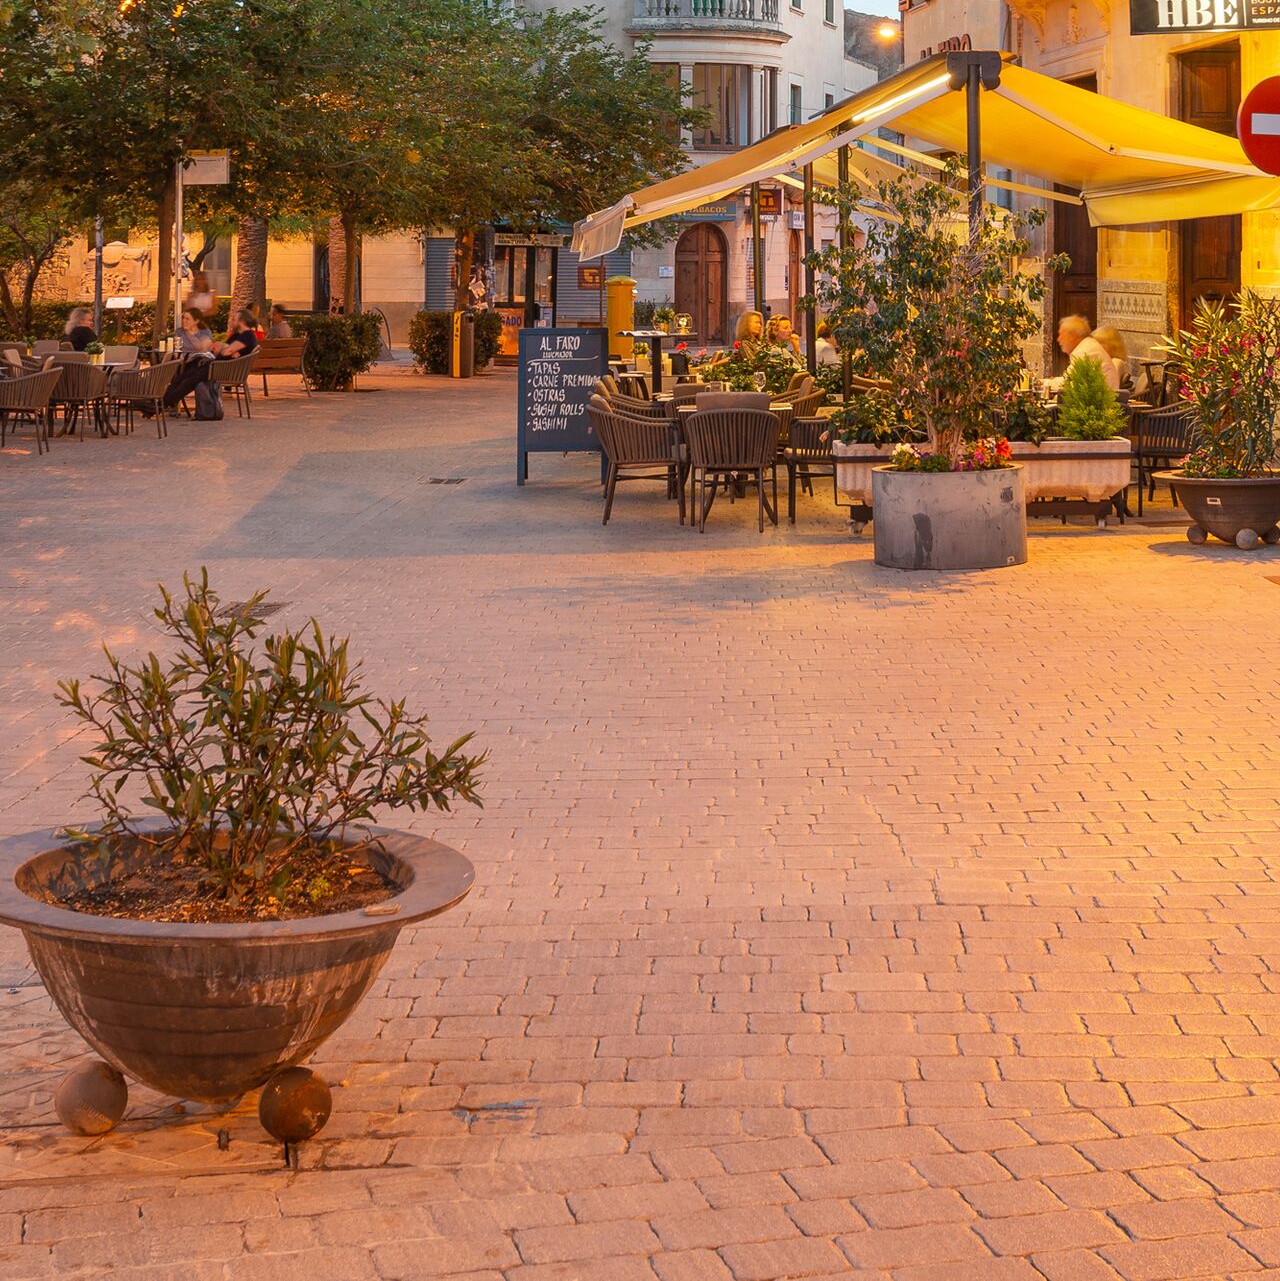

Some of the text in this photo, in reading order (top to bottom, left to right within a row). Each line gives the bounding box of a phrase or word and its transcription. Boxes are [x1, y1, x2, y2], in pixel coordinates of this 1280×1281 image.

[540, 335, 581, 351] AL FARO
[531, 362, 561, 375] TAPAS
[532, 375, 559, 388] CARNE
[533, 388, 566, 402] OSTRAS
[531, 403, 585, 416] SUSHI ROLLS
[532, 417, 568, 431] SASHIMI
